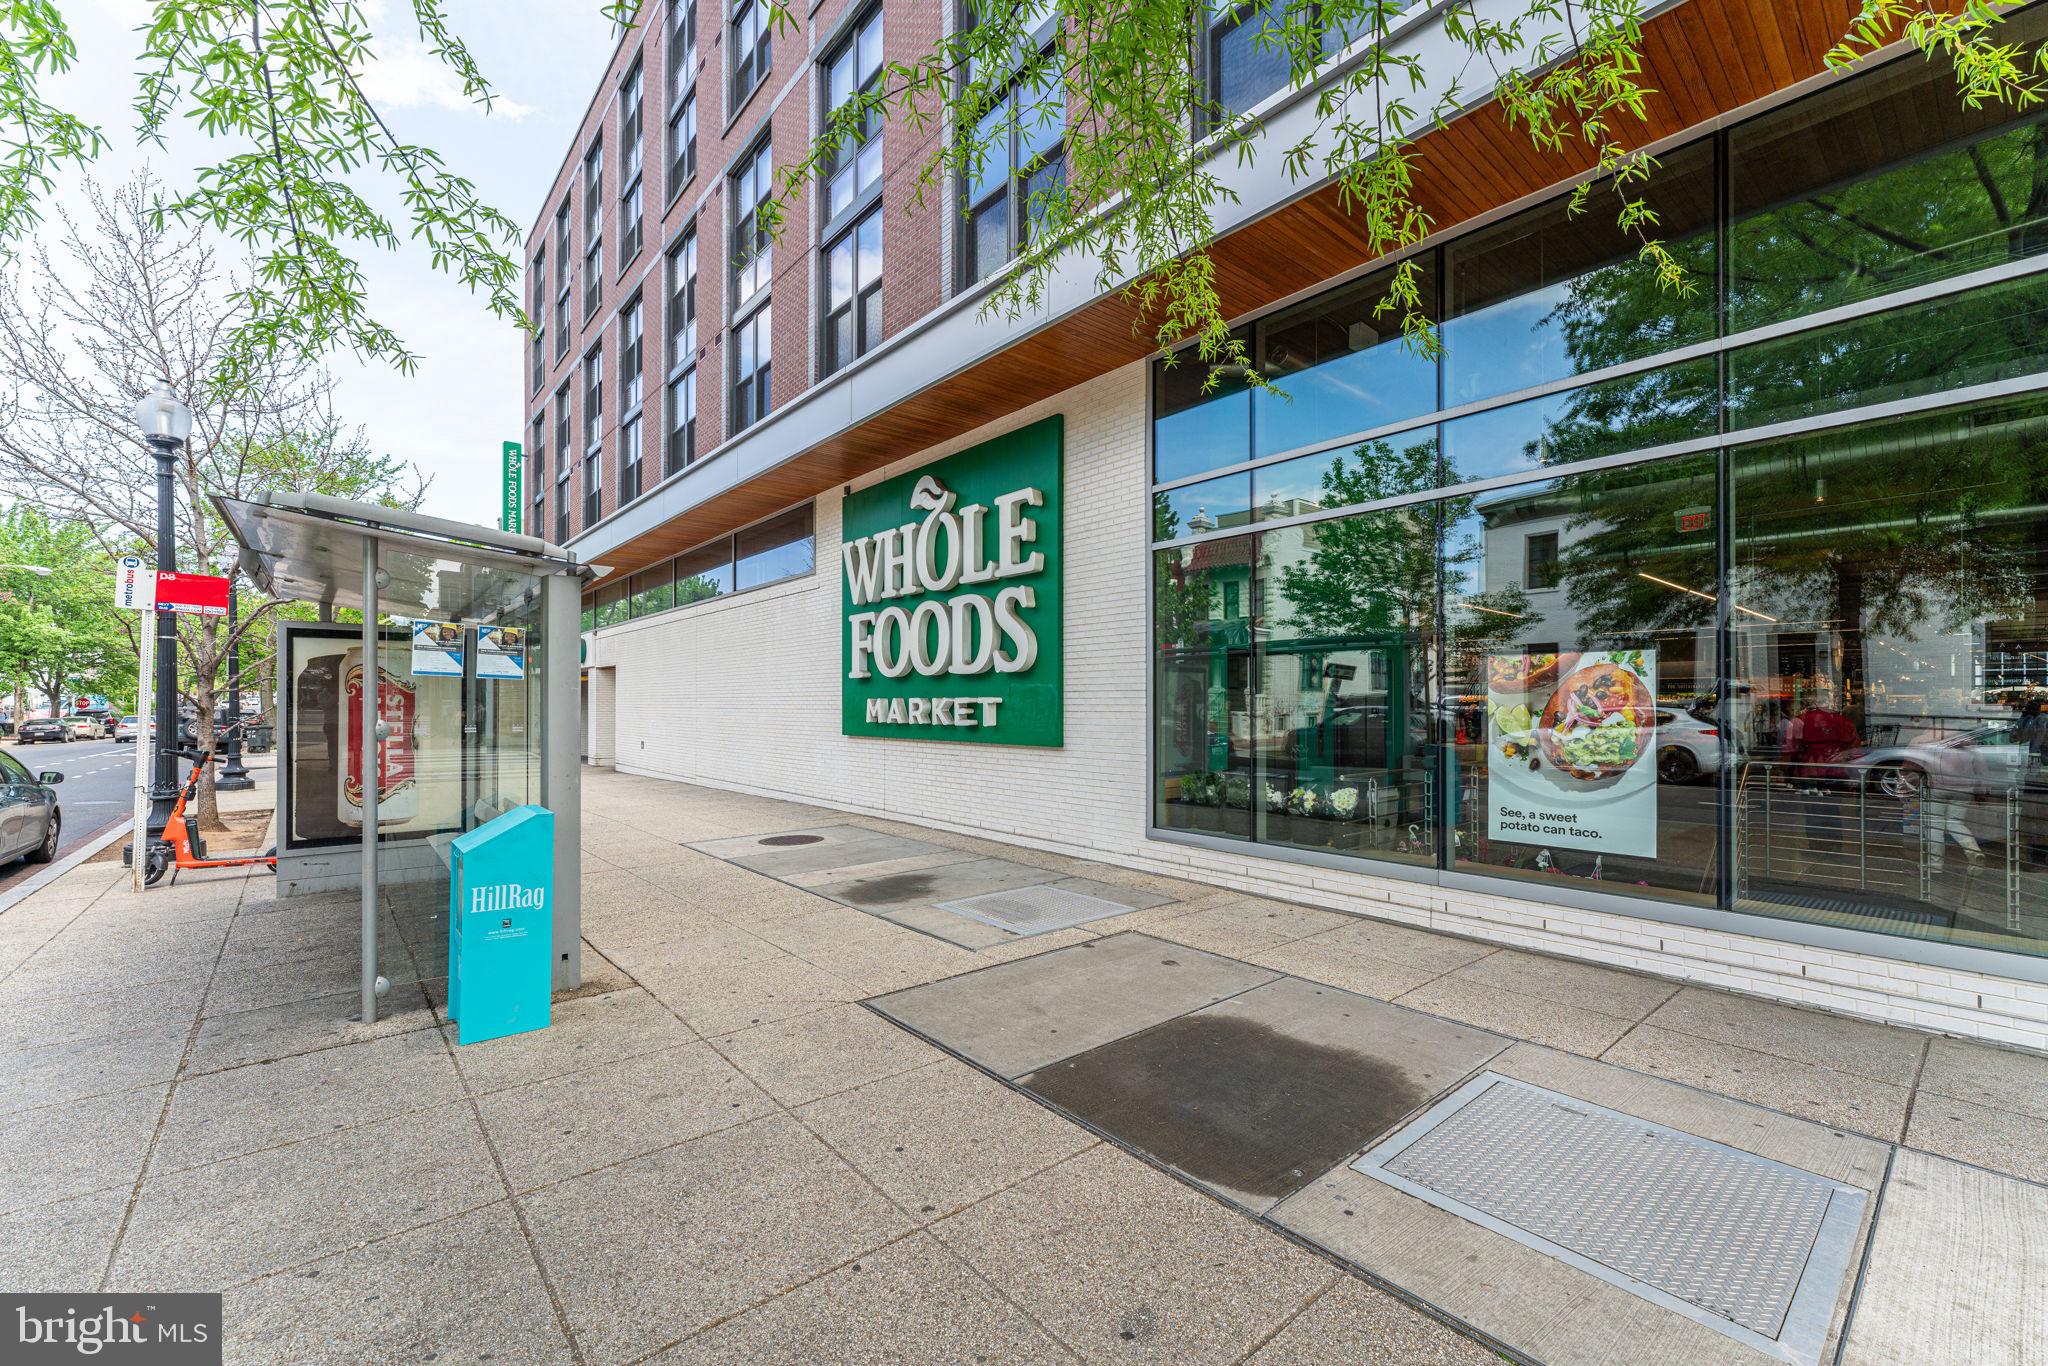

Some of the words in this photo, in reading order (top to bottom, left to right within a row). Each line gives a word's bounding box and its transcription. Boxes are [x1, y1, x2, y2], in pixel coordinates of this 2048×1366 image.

[508, 449, 521, 479] WHOLE
[508, 481, 517, 509] FOODS
[1681, 513, 1705, 531] EXIT
[841, 475, 1045, 606] WHOLE
[125, 569, 135, 606] metrobus
[160, 572, 176, 581] D8
[848, 585, 1038, 679] FOODS
[865, 696, 1003, 727] MARKET
[386, 694, 404, 777] STELLA
[1500, 806, 1526, 821] See,
[1528, 811, 1536, 820] a
[1539, 811, 1578, 823] sweet
[1500, 821, 1540, 832] potato
[1543, 826, 1566, 835] can
[1569, 826, 1602, 839] taco.
[470, 884, 545, 912] HillRag
